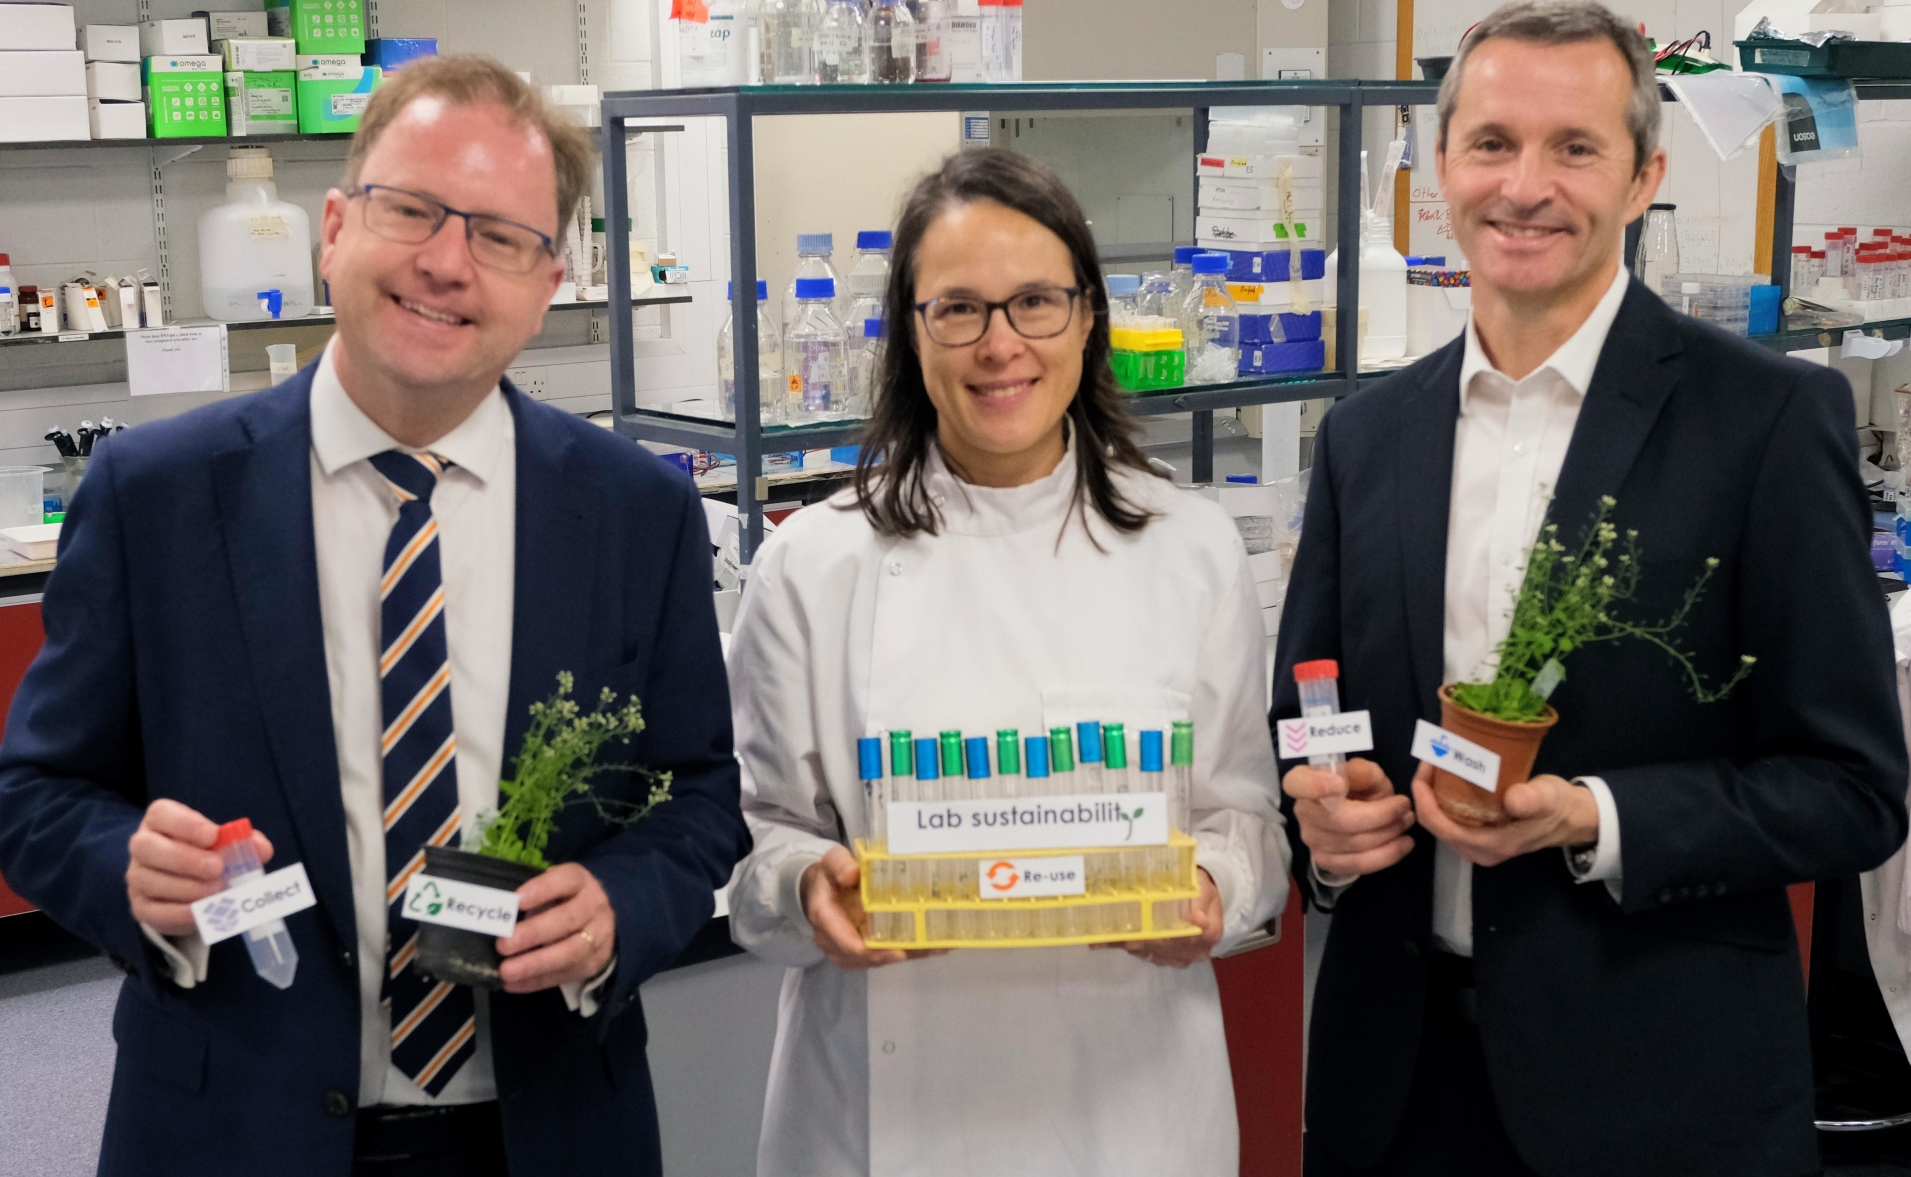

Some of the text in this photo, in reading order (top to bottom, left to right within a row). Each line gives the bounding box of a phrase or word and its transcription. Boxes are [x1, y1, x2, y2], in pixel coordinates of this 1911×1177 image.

[180, 60, 206, 68] omega
[320, 59, 345, 67] omega
[1412, 186, 1439, 199] Other
[1309, 722, 1362, 738] Reduce
[1452, 749, 1487, 774] Wash
[916, 801, 1144, 841] Lab sustainability
[1023, 869, 1076, 883] Re-use
[241, 881, 301, 913] Collect
[446, 897, 512, 922] Recycle
